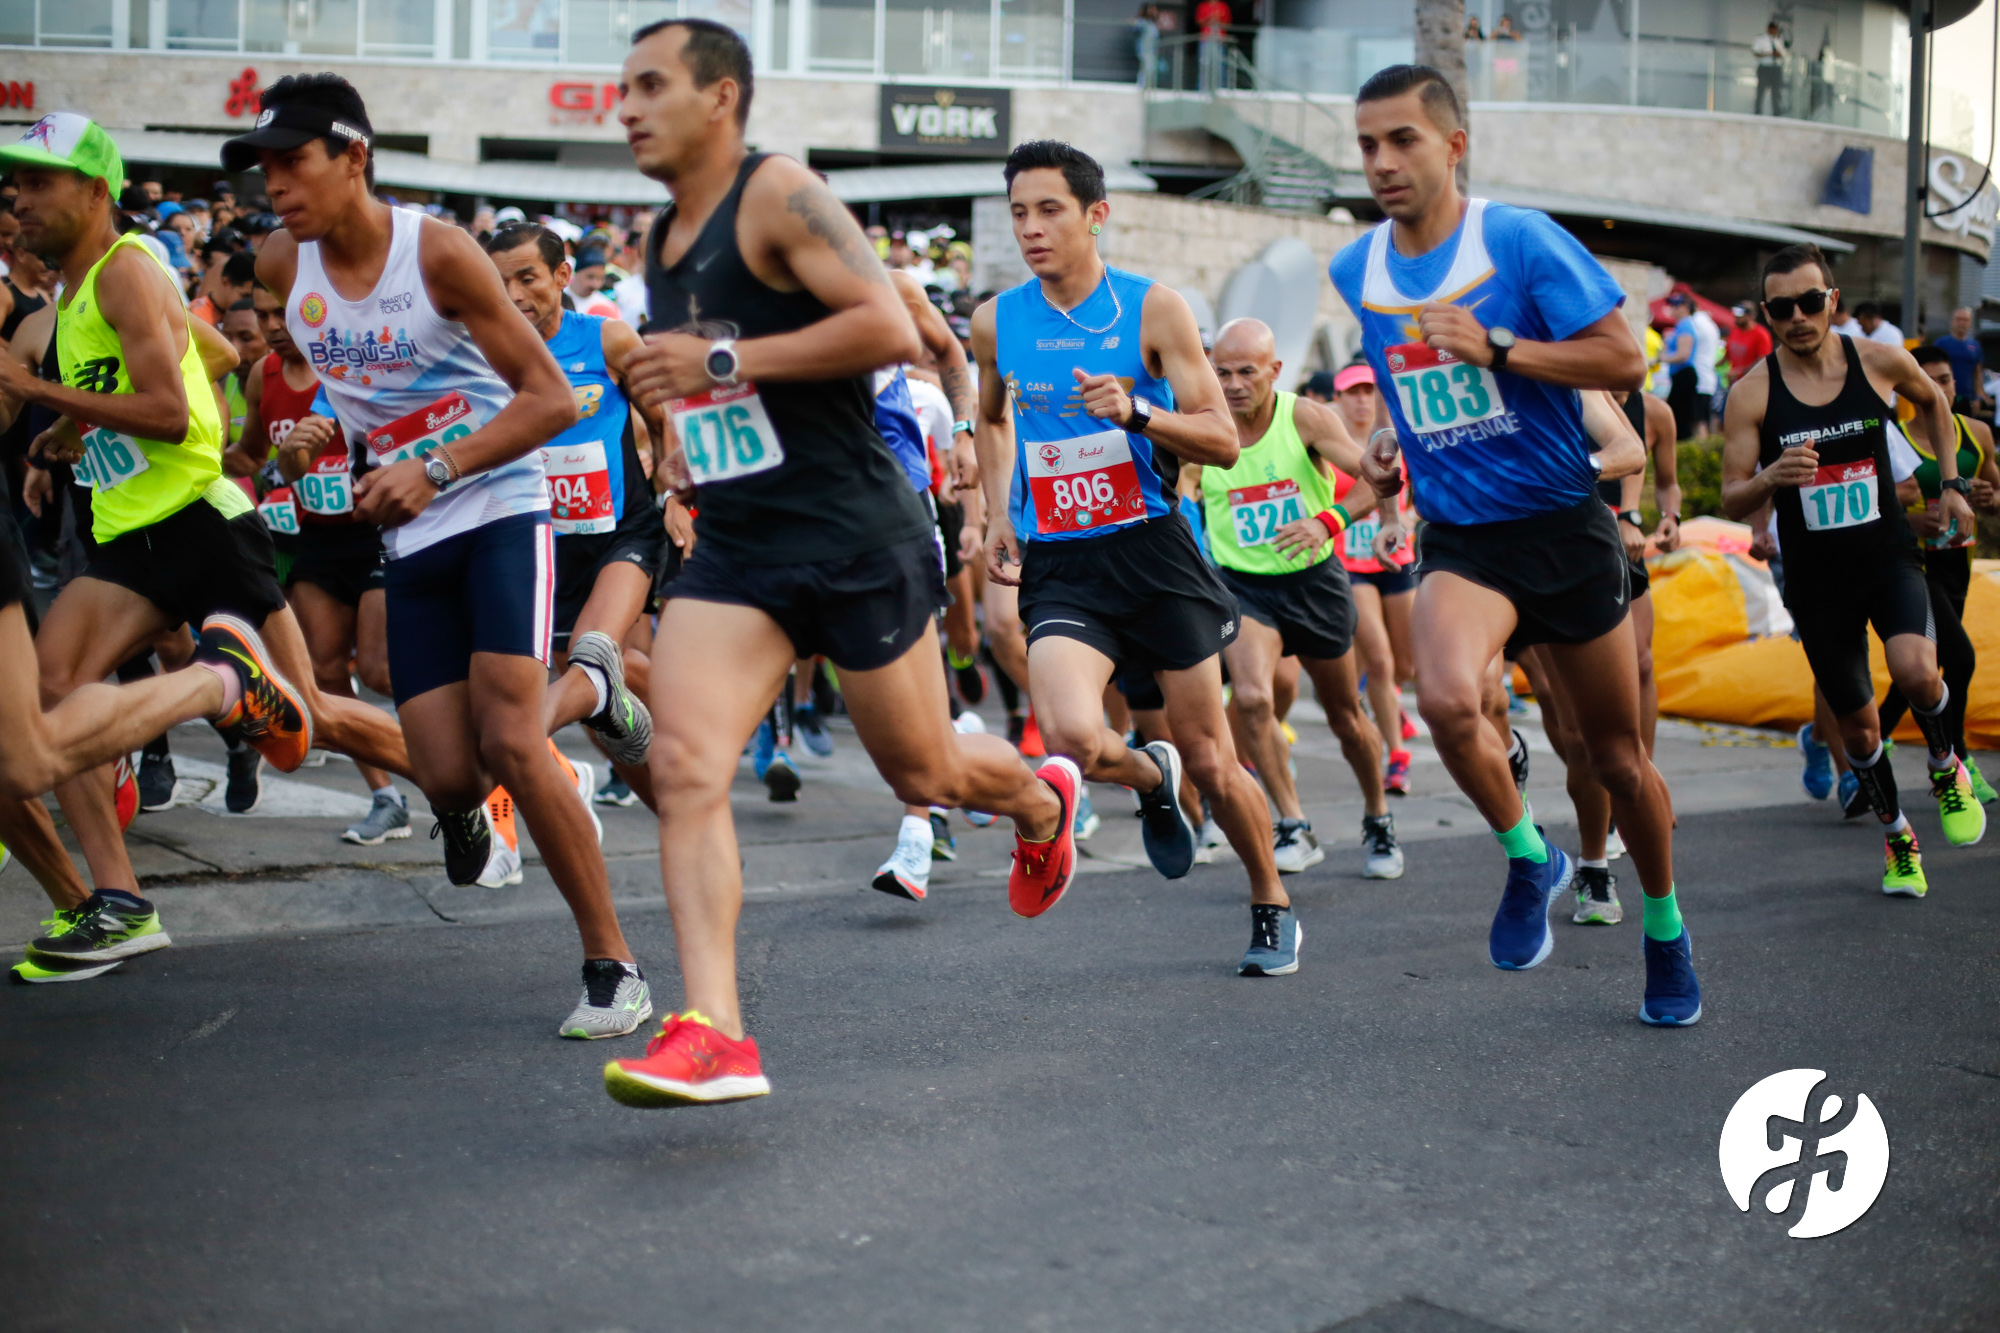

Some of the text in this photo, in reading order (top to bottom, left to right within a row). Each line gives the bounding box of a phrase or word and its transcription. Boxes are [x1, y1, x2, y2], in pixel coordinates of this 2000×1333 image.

[379, 294, 402, 306] SMART
[380, 303, 405, 315] TOOL
[1036, 339, 1085, 348] Sports Balance
[307, 339, 418, 368] Begushi
[1026, 382, 1054, 392] CASA
[1031, 394, 1050, 403] DEL
[1397, 364, 1490, 428] 783
[1034, 405, 1050, 414] PIE
[684, 405, 764, 475] 476
[1052, 472, 1114, 510] 806
[1809, 481, 1870, 526] 170
[575, 522, 595, 533] 804
